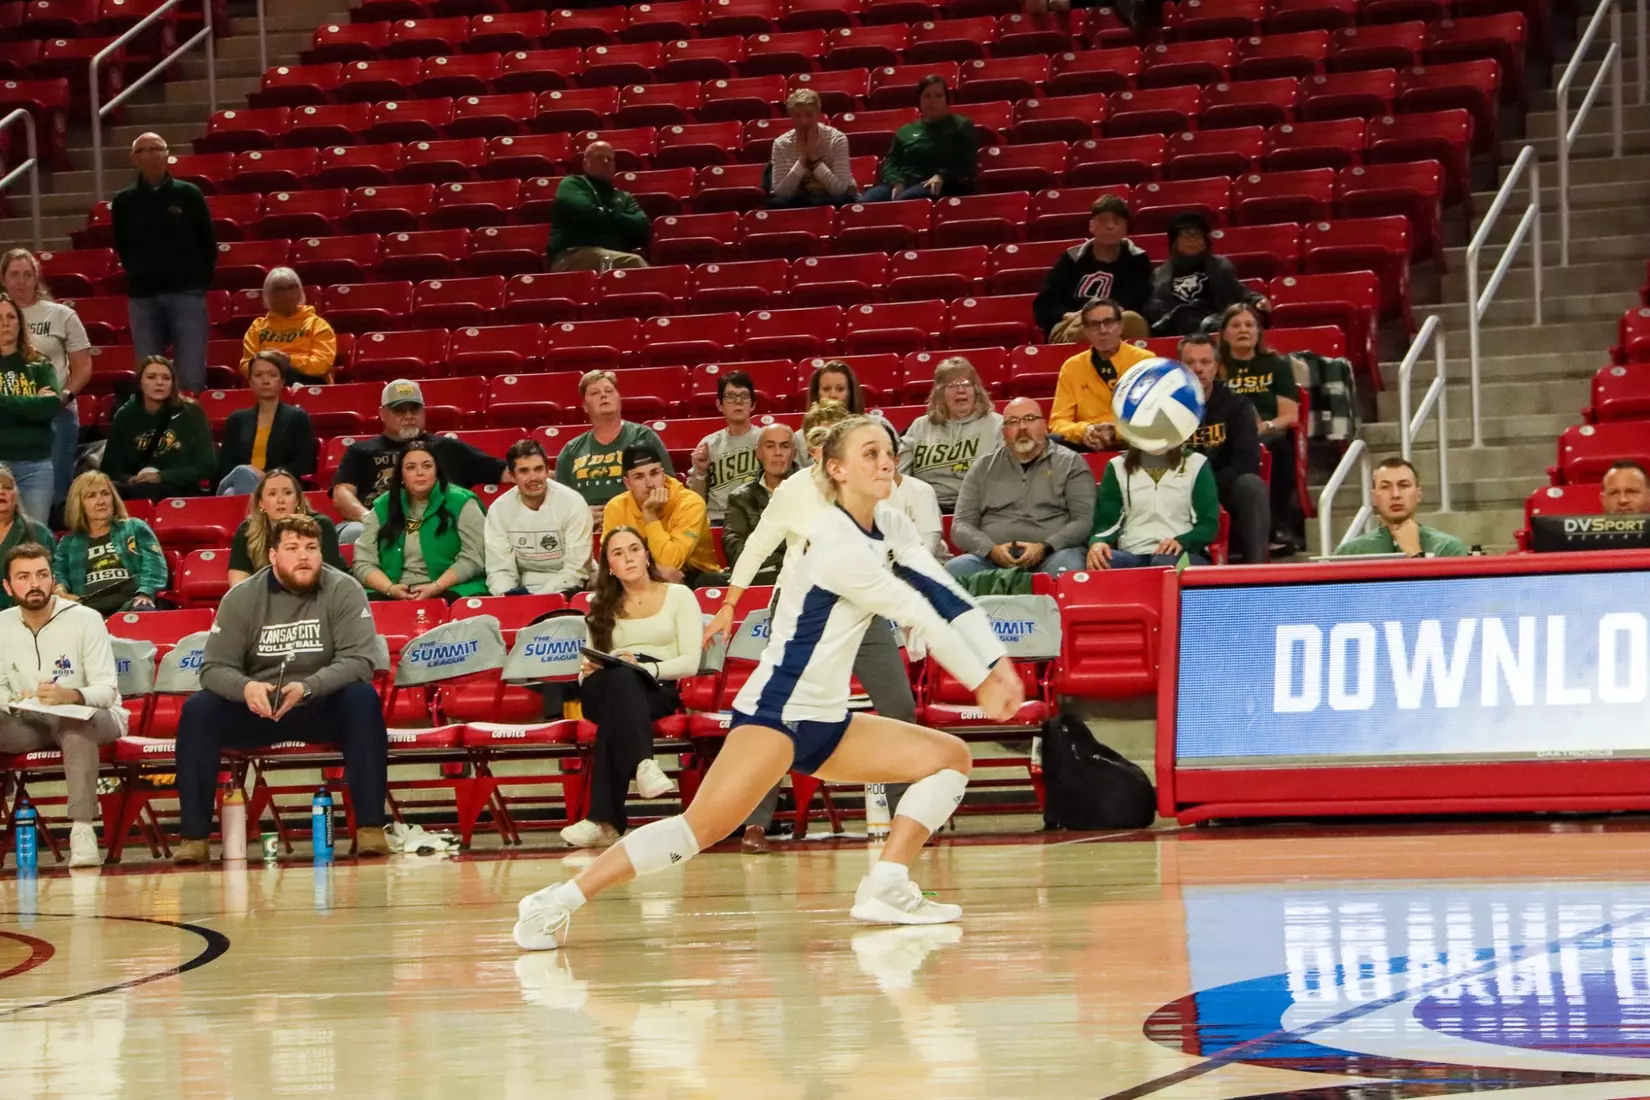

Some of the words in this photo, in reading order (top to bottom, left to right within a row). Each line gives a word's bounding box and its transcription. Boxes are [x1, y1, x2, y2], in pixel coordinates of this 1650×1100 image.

[28, 321, 52, 336] SON
[914, 437, 980, 469] BISON
[707, 449, 757, 488] BISO
[1563, 518, 1646, 533] DVSPORT
[86, 568, 129, 584] BISO
[259, 626, 298, 644] KANSAS
[299, 623, 321, 639] CITY
[990, 621, 1035, 634] MMIT
[410, 639, 479, 663] SUMMIT
[419, 640, 437, 648] THE
[427, 657, 466, 668] LEAGUE
[540, 653, 578, 663] LEAGUE
[1273, 612, 1648, 713] DOWNLO
[387, 735, 417, 743] OYOTES
[26, 750, 62, 760] COYOTES
